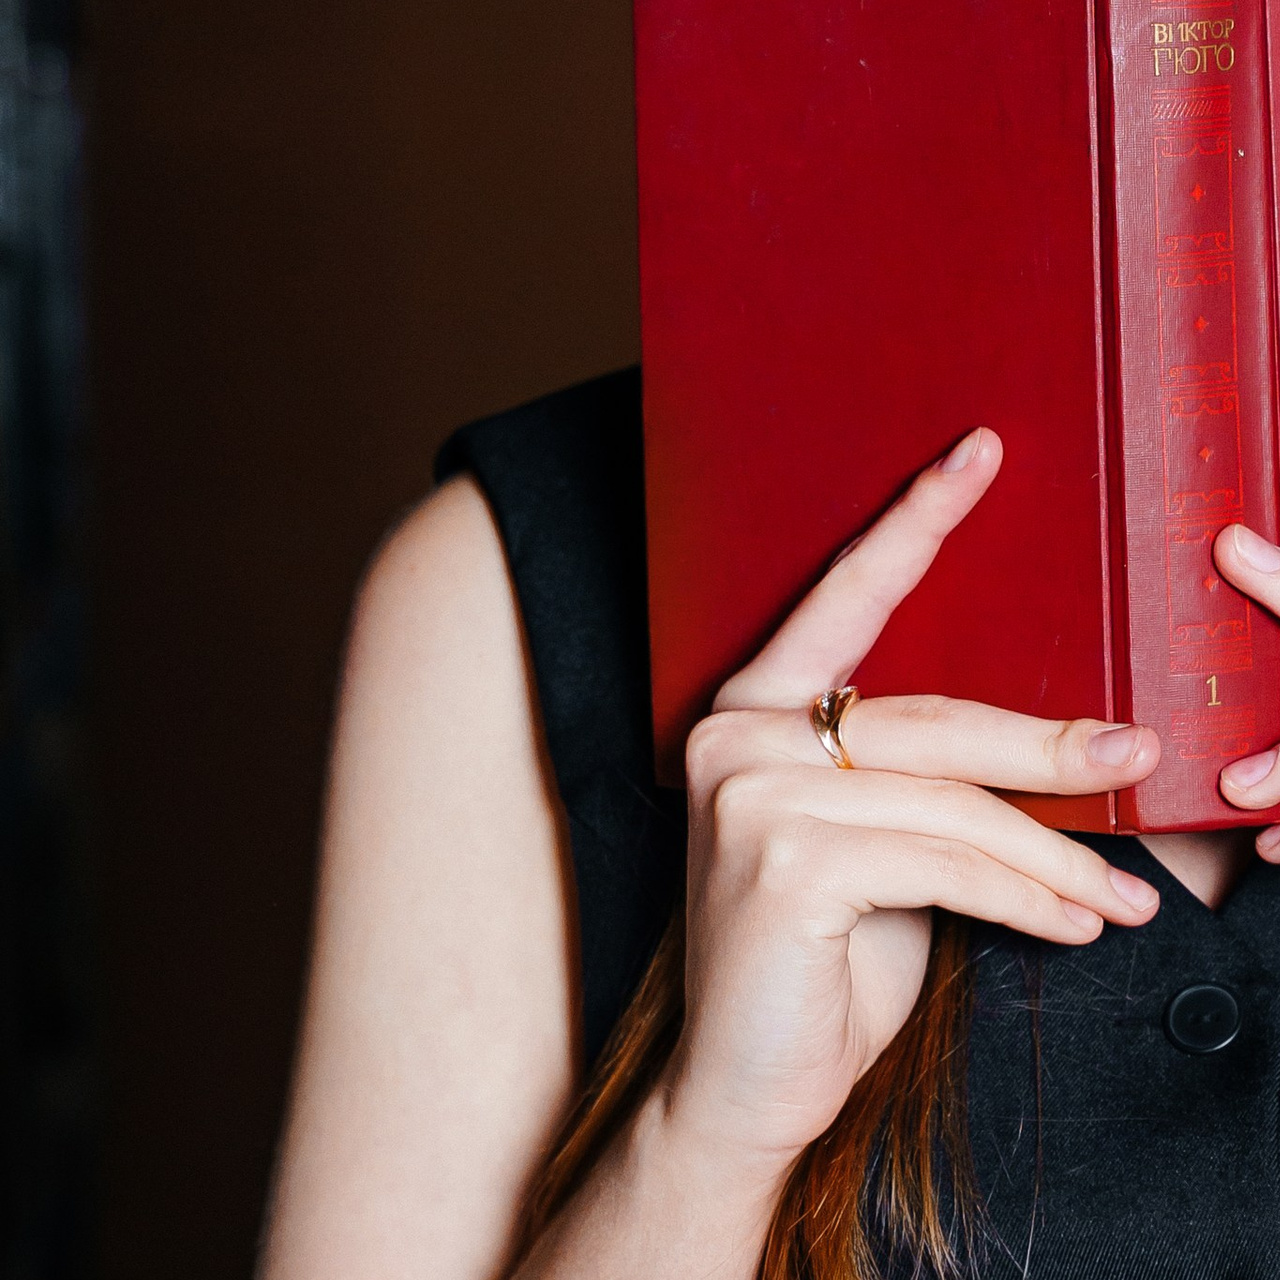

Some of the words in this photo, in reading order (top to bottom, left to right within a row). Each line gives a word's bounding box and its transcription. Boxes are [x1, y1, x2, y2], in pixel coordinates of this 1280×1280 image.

[1152, 20, 1235, 43] ВИКТОР
[1151, 43, 1235, 76] ГЮГО
[1206, 675, 1221, 706] 1
